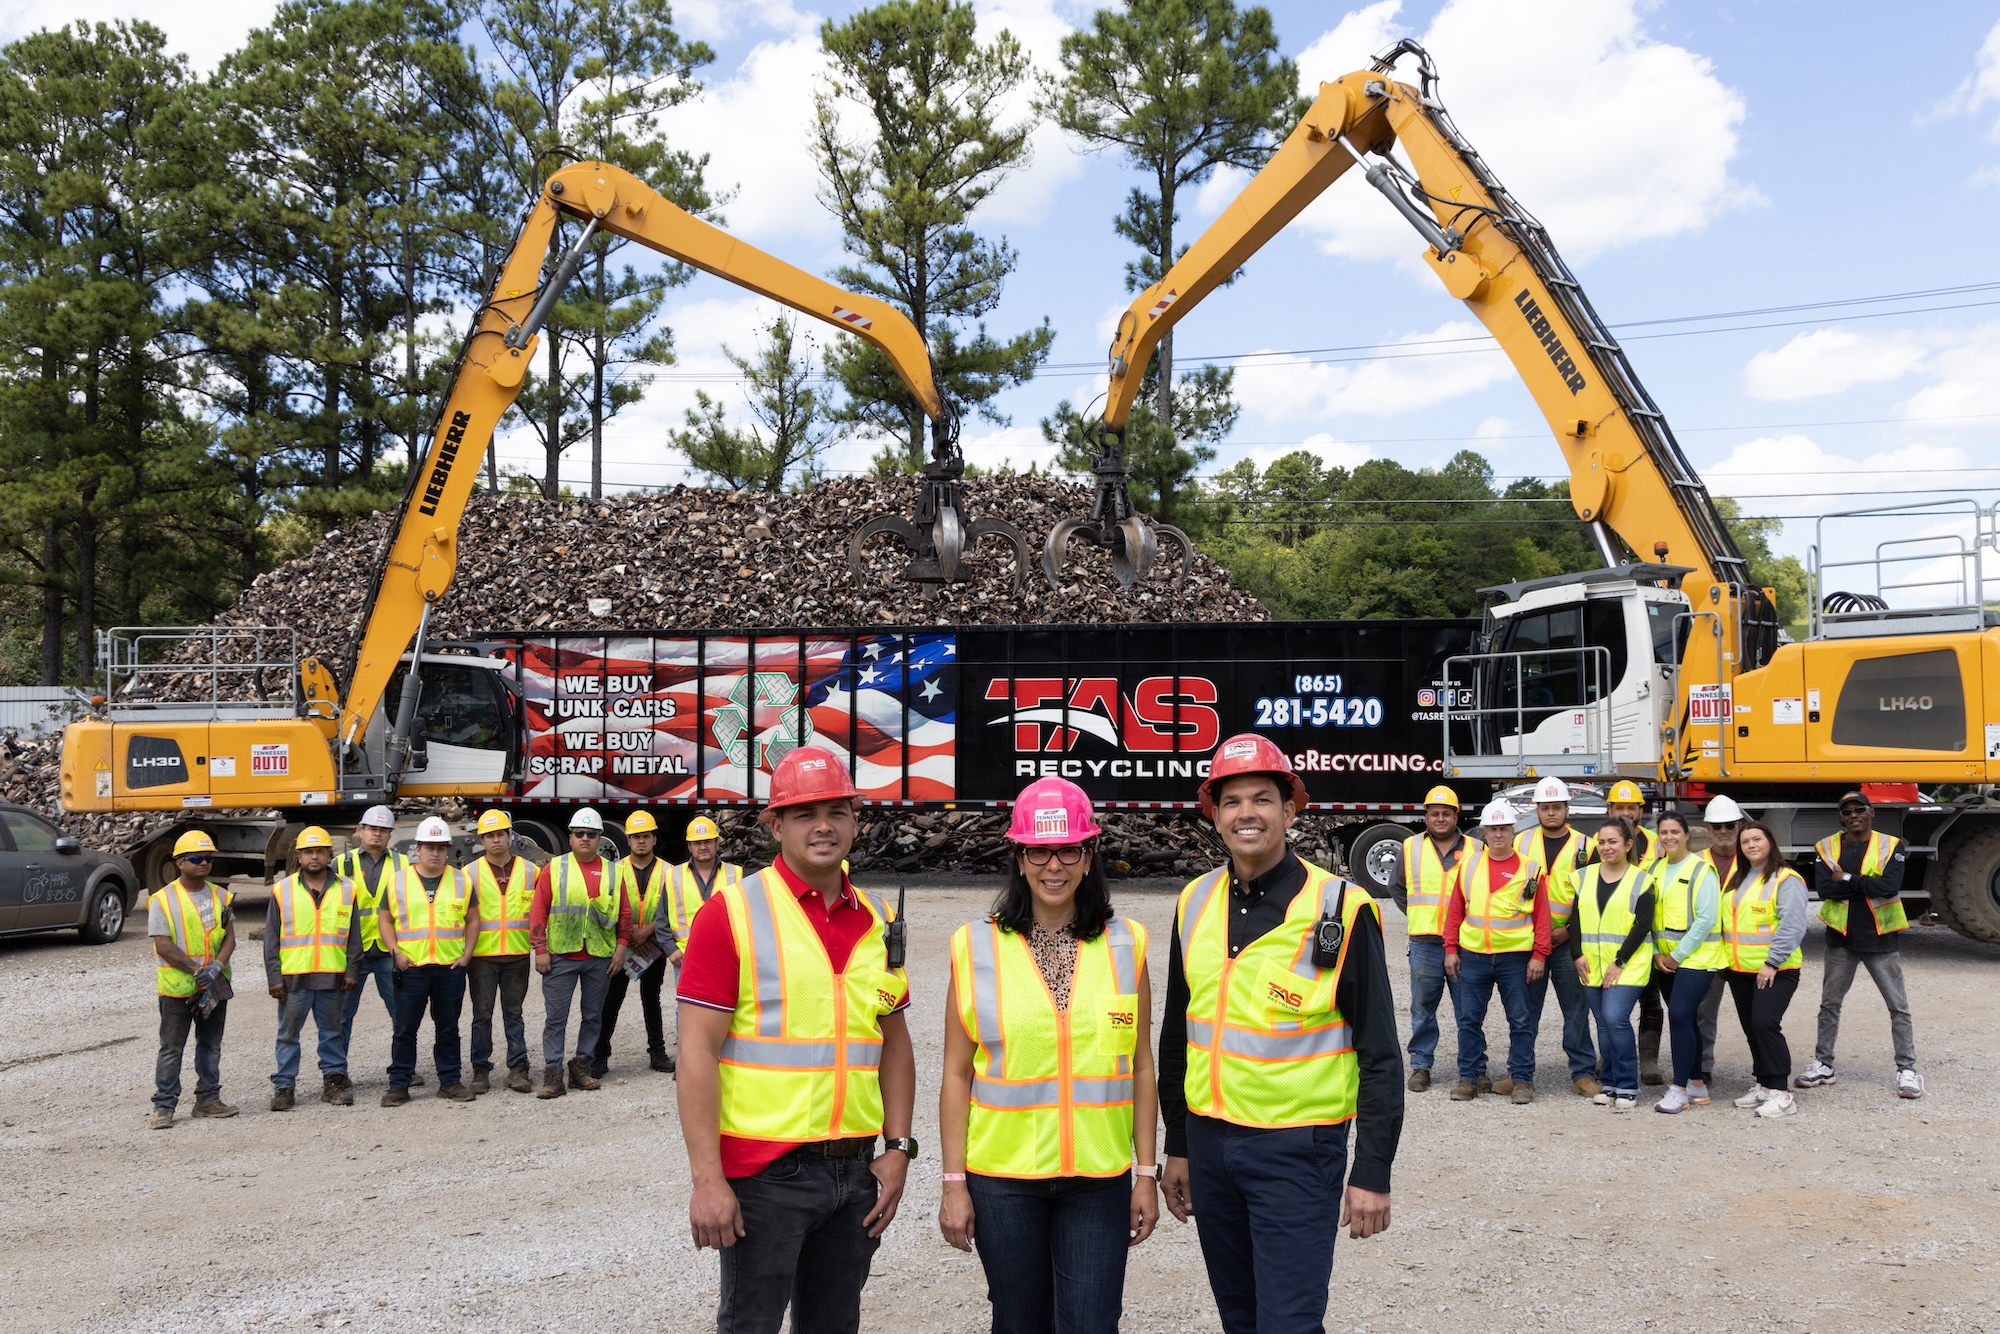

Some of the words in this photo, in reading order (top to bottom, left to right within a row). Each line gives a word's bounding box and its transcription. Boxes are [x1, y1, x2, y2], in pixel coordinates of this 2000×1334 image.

[1514, 288, 1586, 397] LIEBHERR
[419, 410, 471, 517] LIEBHERR
[565, 675, 600, 694] WE
[606, 675, 654, 694] BUY
[1295, 674, 1342, 694] (865)
[543, 699, 607, 717] JUNK
[613, 698, 676, 717] CARS
[1254, 697, 1384, 727] 281-5420
[1691, 698, 1730, 717] AUTO
[1880, 695, 1933, 711] LH40
[984, 676, 1220, 753] TAS
[564, 732, 599, 750] WE
[606, 732, 654, 750] BUY
[132, 756, 180, 767] LH30
[253, 756, 287, 770] AUTO
[530, 756, 606, 774] SCRAP
[612, 756, 688, 774] METAL
[1015, 759, 1212, 777] RECYCLING
[1036, 820, 1067, 833] AUTO
[1268, 981, 1303, 1008] TAS
[1107, 1012, 1134, 1025] TAS
